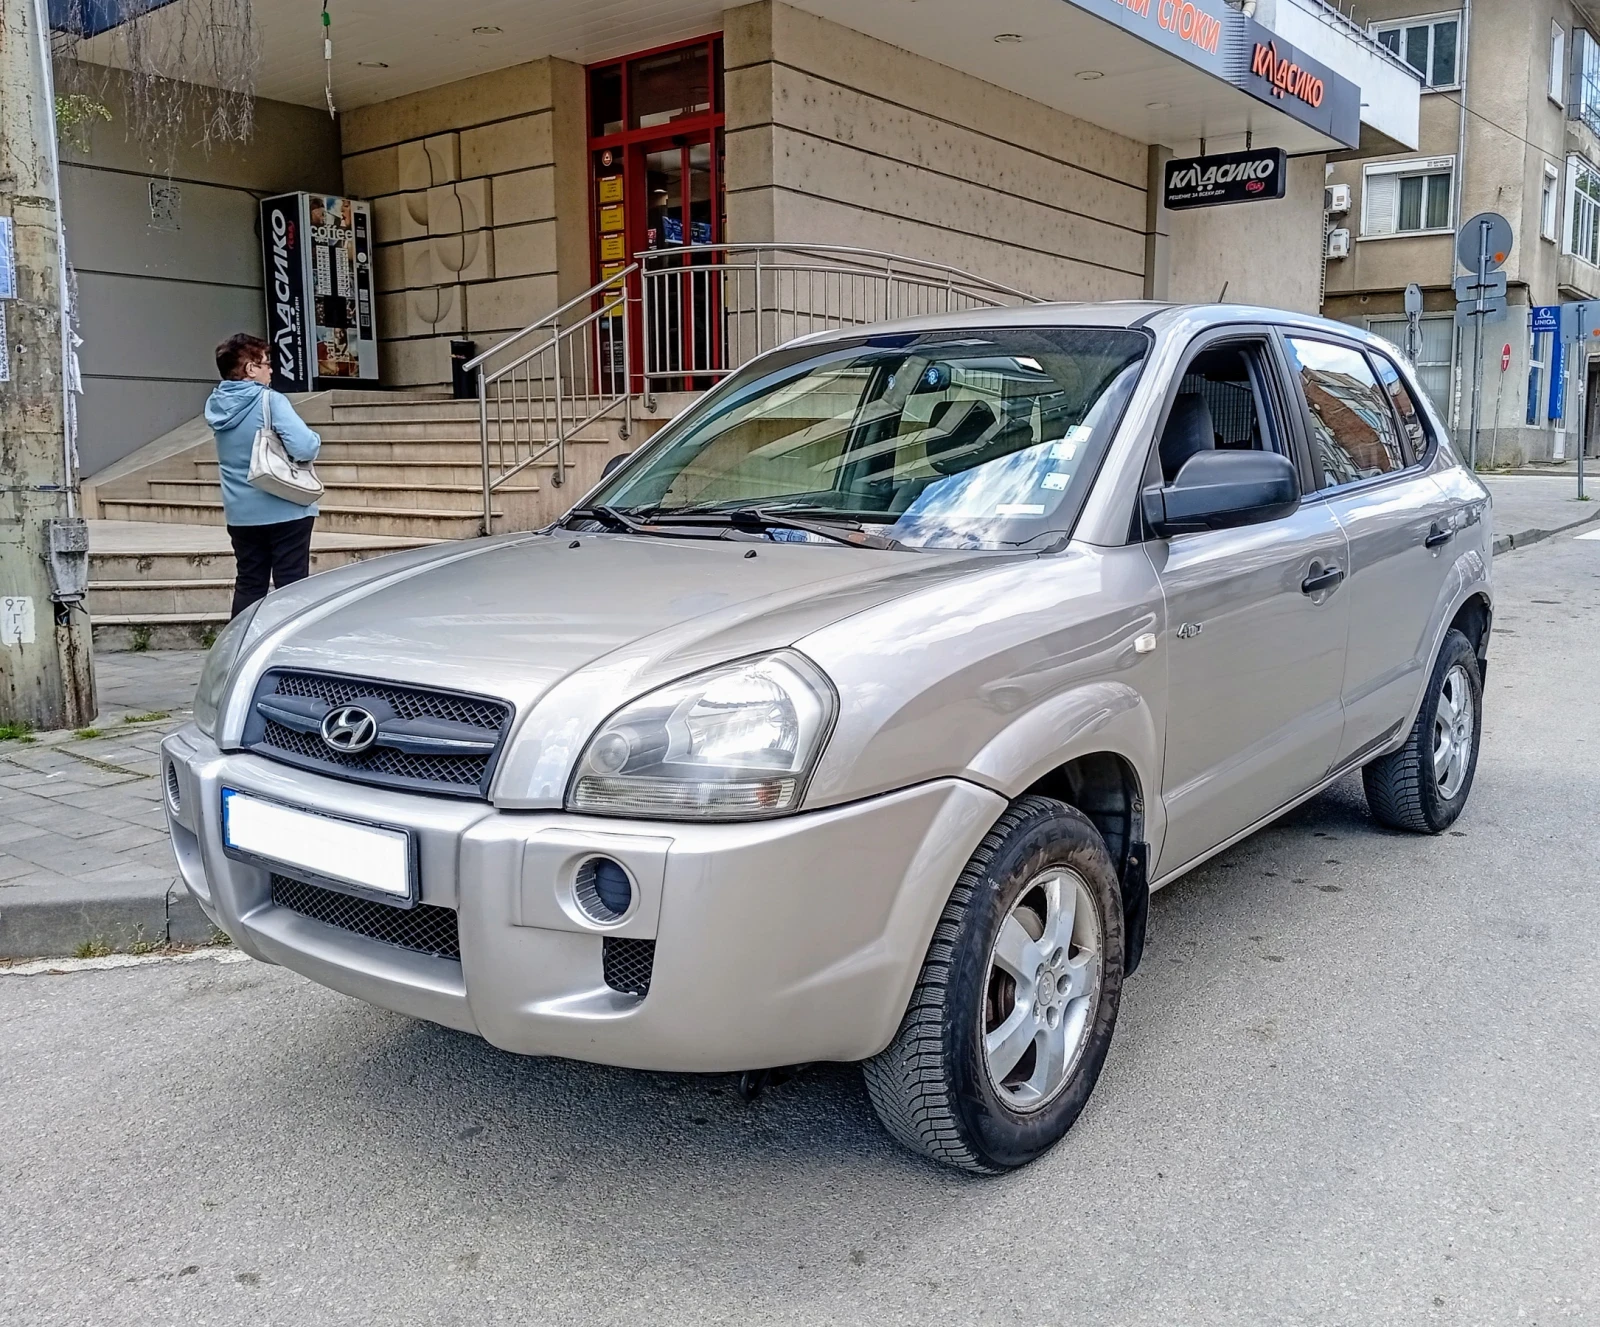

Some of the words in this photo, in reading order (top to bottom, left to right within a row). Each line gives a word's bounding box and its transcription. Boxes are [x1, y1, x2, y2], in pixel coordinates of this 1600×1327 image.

[1157, 0, 1221, 54] СТОКИ
[1251, 39, 1324, 108] КЛАСИКО
[1169, 159, 1274, 190] КЛАСИКО
[310, 225, 353, 240] coffee
[272, 209, 295, 381] КЛАСИКО
[5, 598, 26, 611] 97
[13, 625, 22, 641] 4
